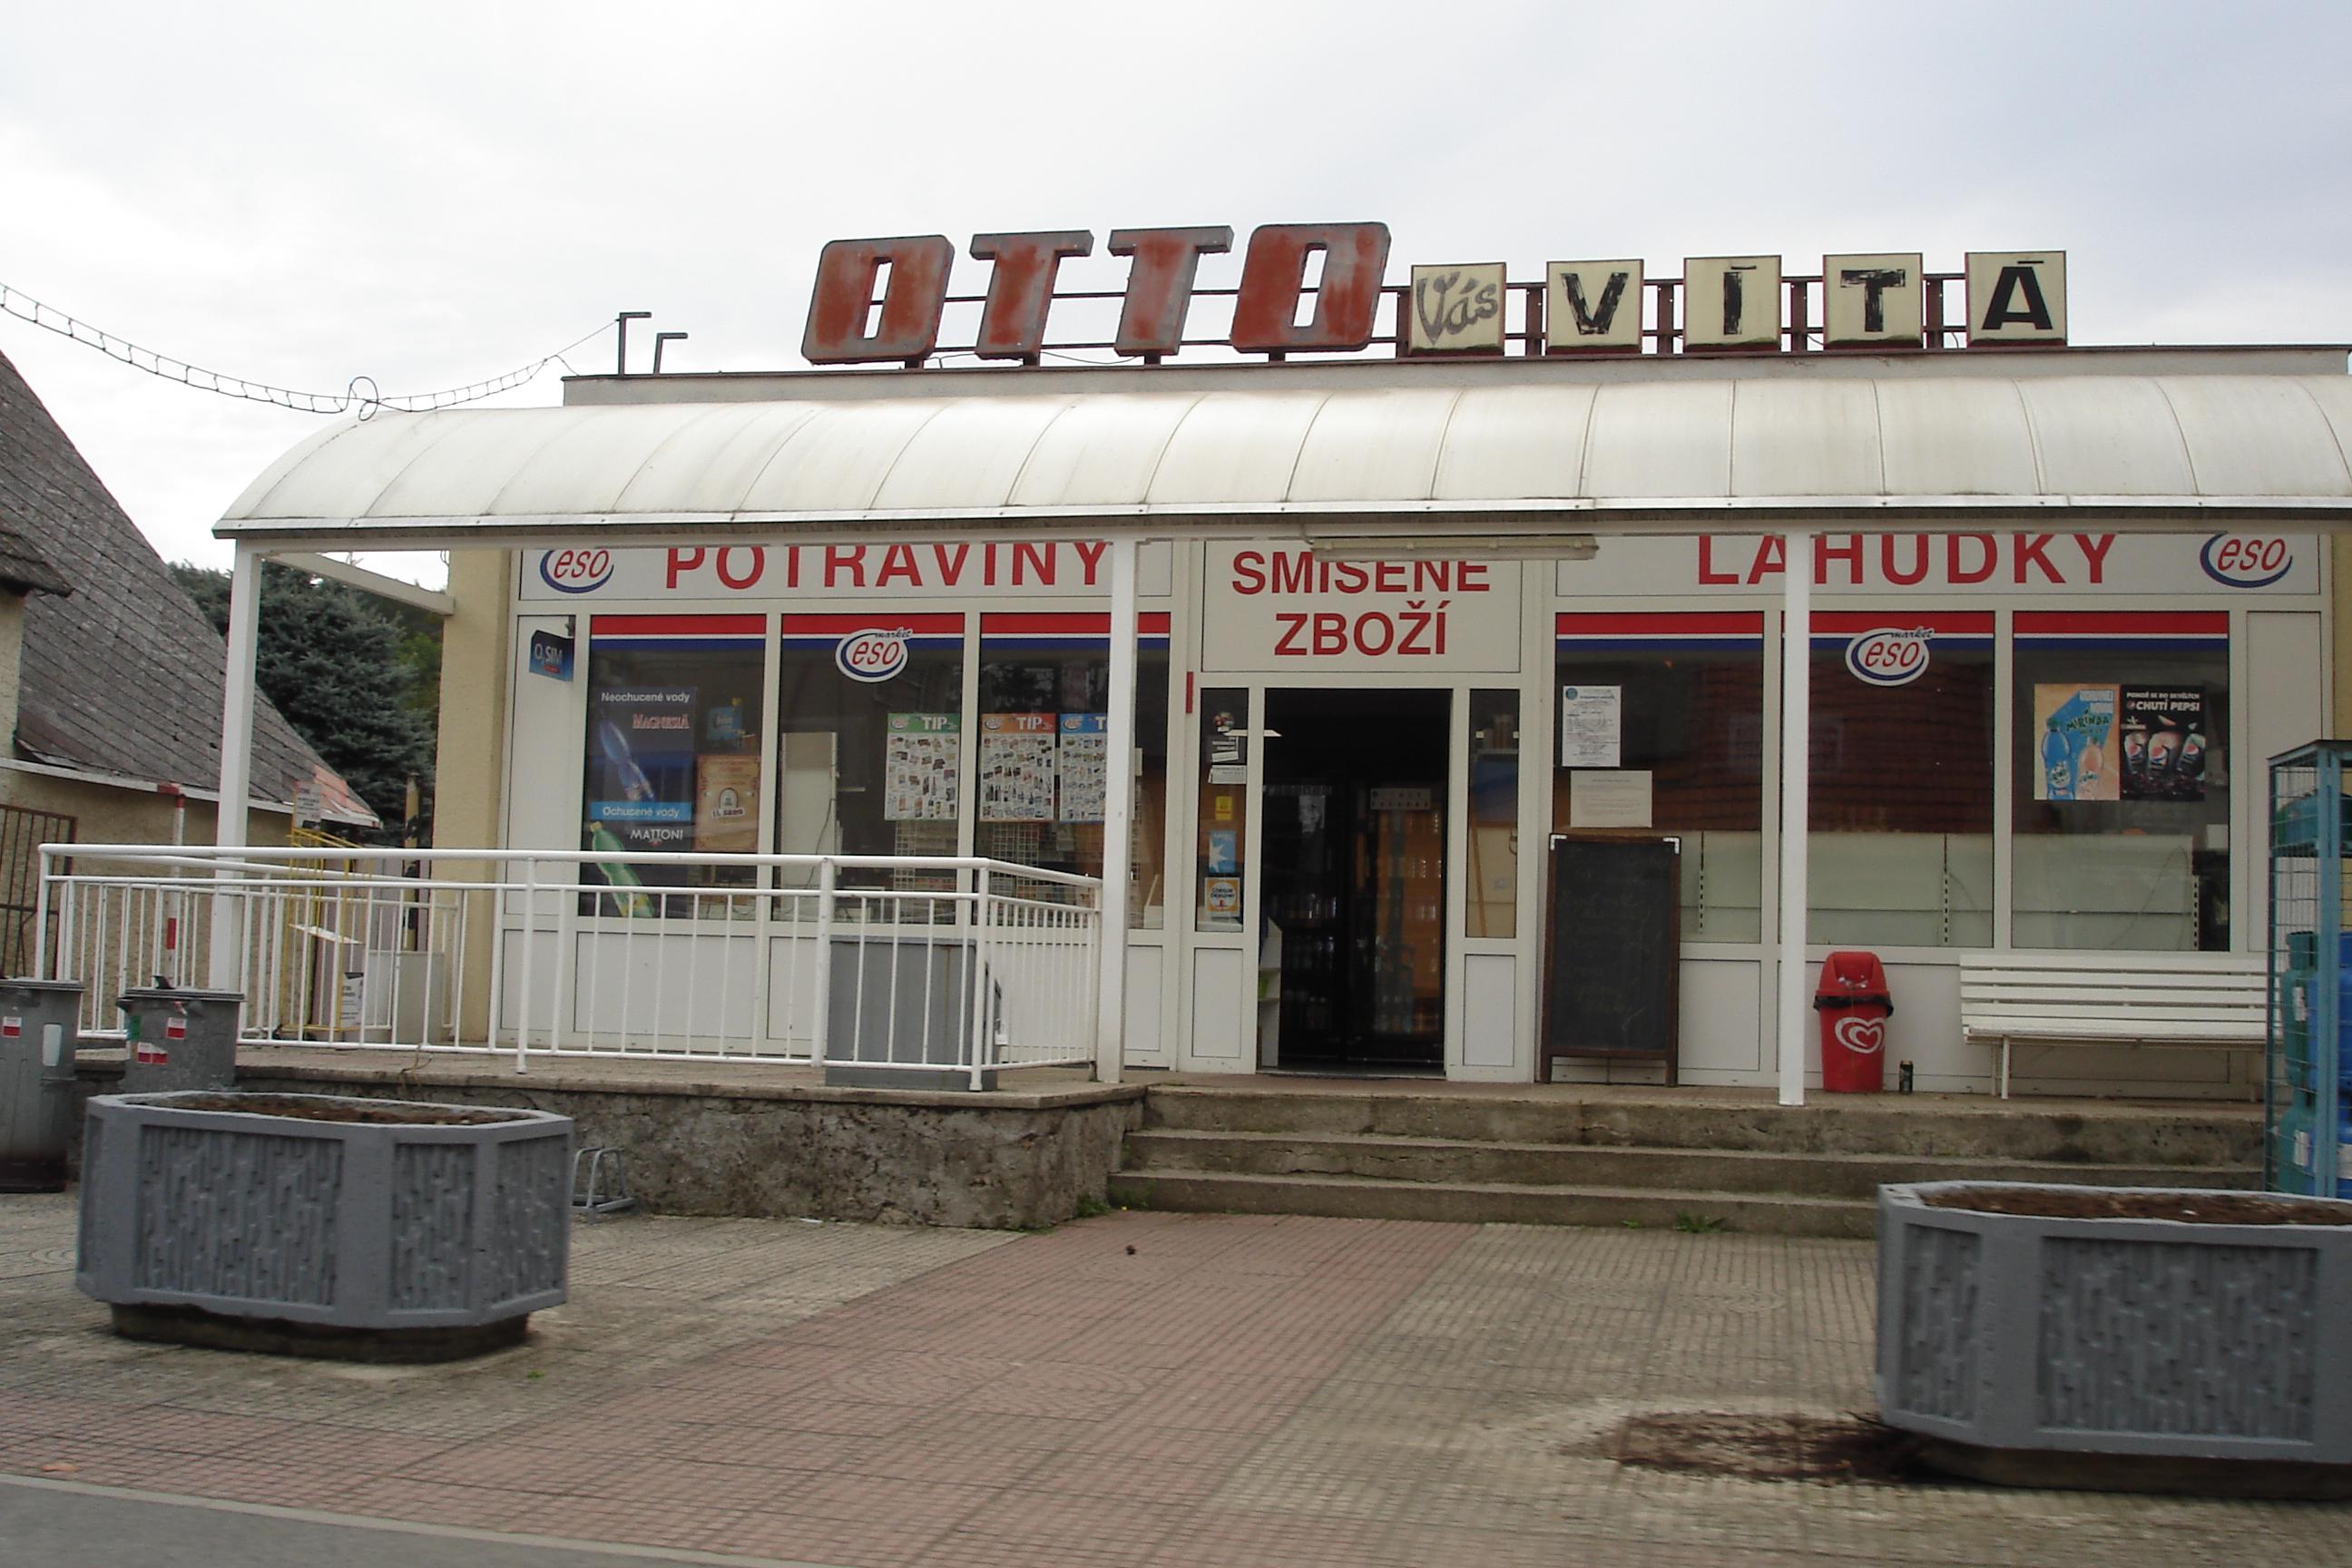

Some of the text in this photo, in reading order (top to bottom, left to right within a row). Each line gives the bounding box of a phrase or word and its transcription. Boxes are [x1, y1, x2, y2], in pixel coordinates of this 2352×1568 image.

[800, 221, 1392, 365] OTTO
[554, 549, 610, 579] eso
[2217, 537, 2287, 572] eso
[1274, 600, 1452, 657] ZBOŽÍ
[851, 641, 900, 666] eso
[1864, 641, 1920, 668] eso
[665, 692, 691, 704] vody
[2170, 701, 2200, 711] PEPSI
[922, 716, 948, 730] TIP
[1016, 716, 1043, 730] TIP
[655, 808, 680, 818] vody
[630, 828, 683, 841] MATTONI
